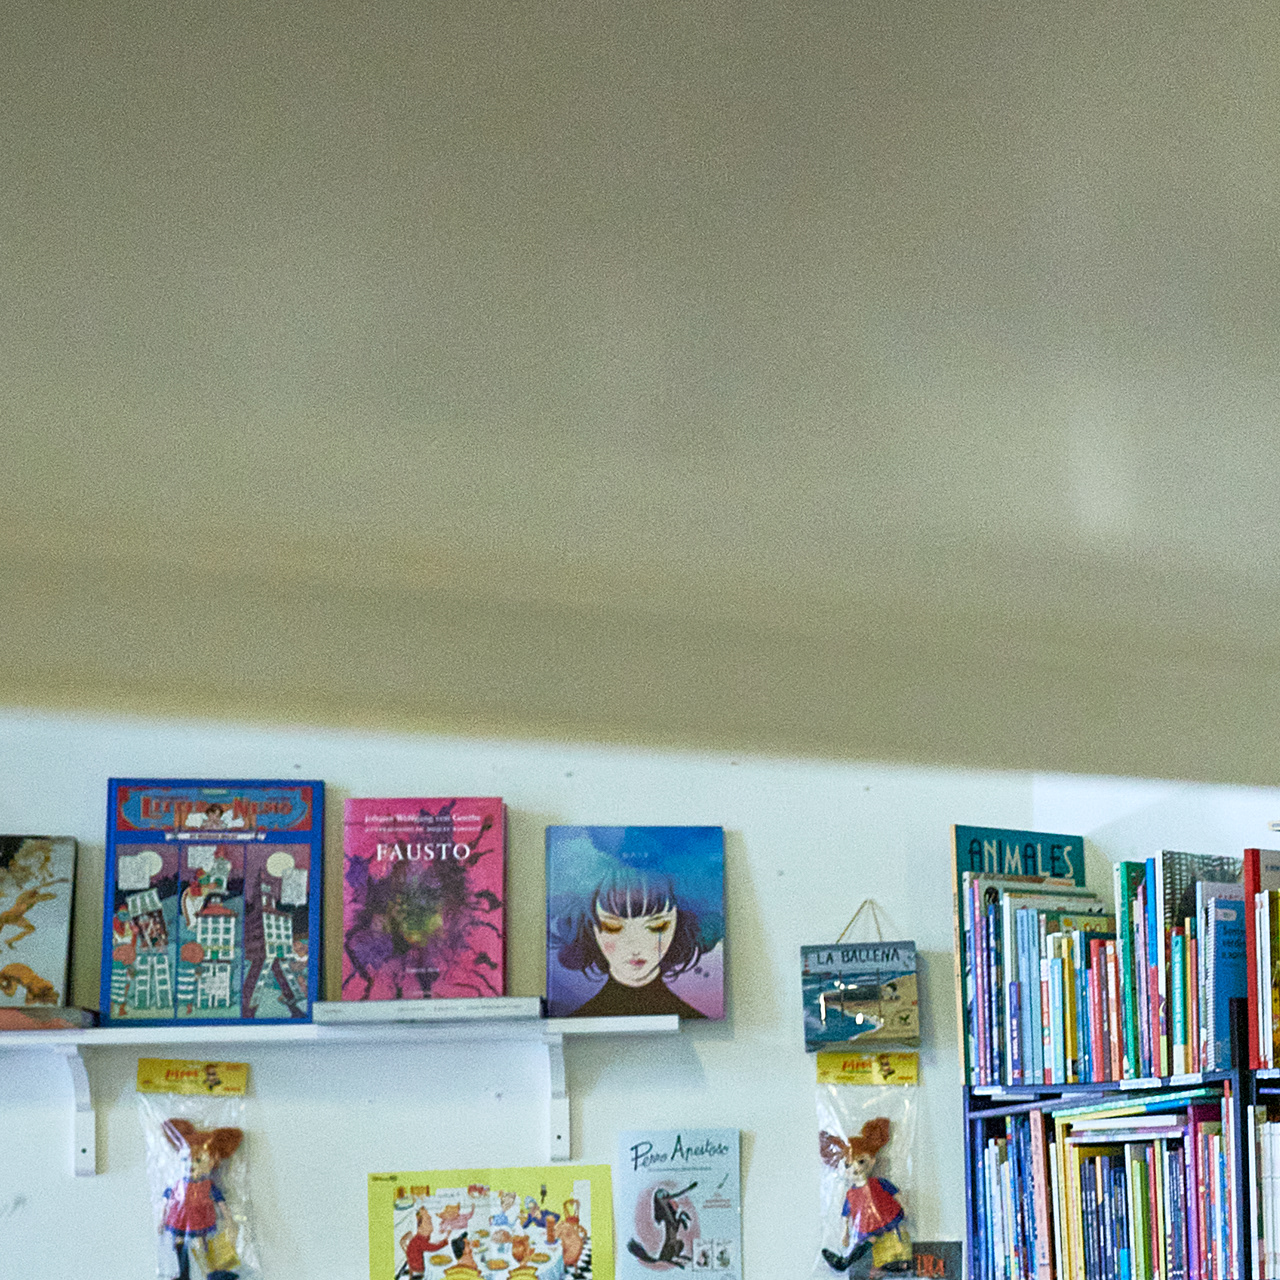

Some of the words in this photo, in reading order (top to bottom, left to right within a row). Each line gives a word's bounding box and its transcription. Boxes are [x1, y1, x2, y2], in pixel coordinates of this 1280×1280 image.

[377, 843, 471, 861] FAUSTO
[968, 839, 1074, 879] ANIMALES
[817, 950, 835, 965] LA
[841, 949, 900, 963] BALLENA
[629, 1141, 667, 1171] Perro
